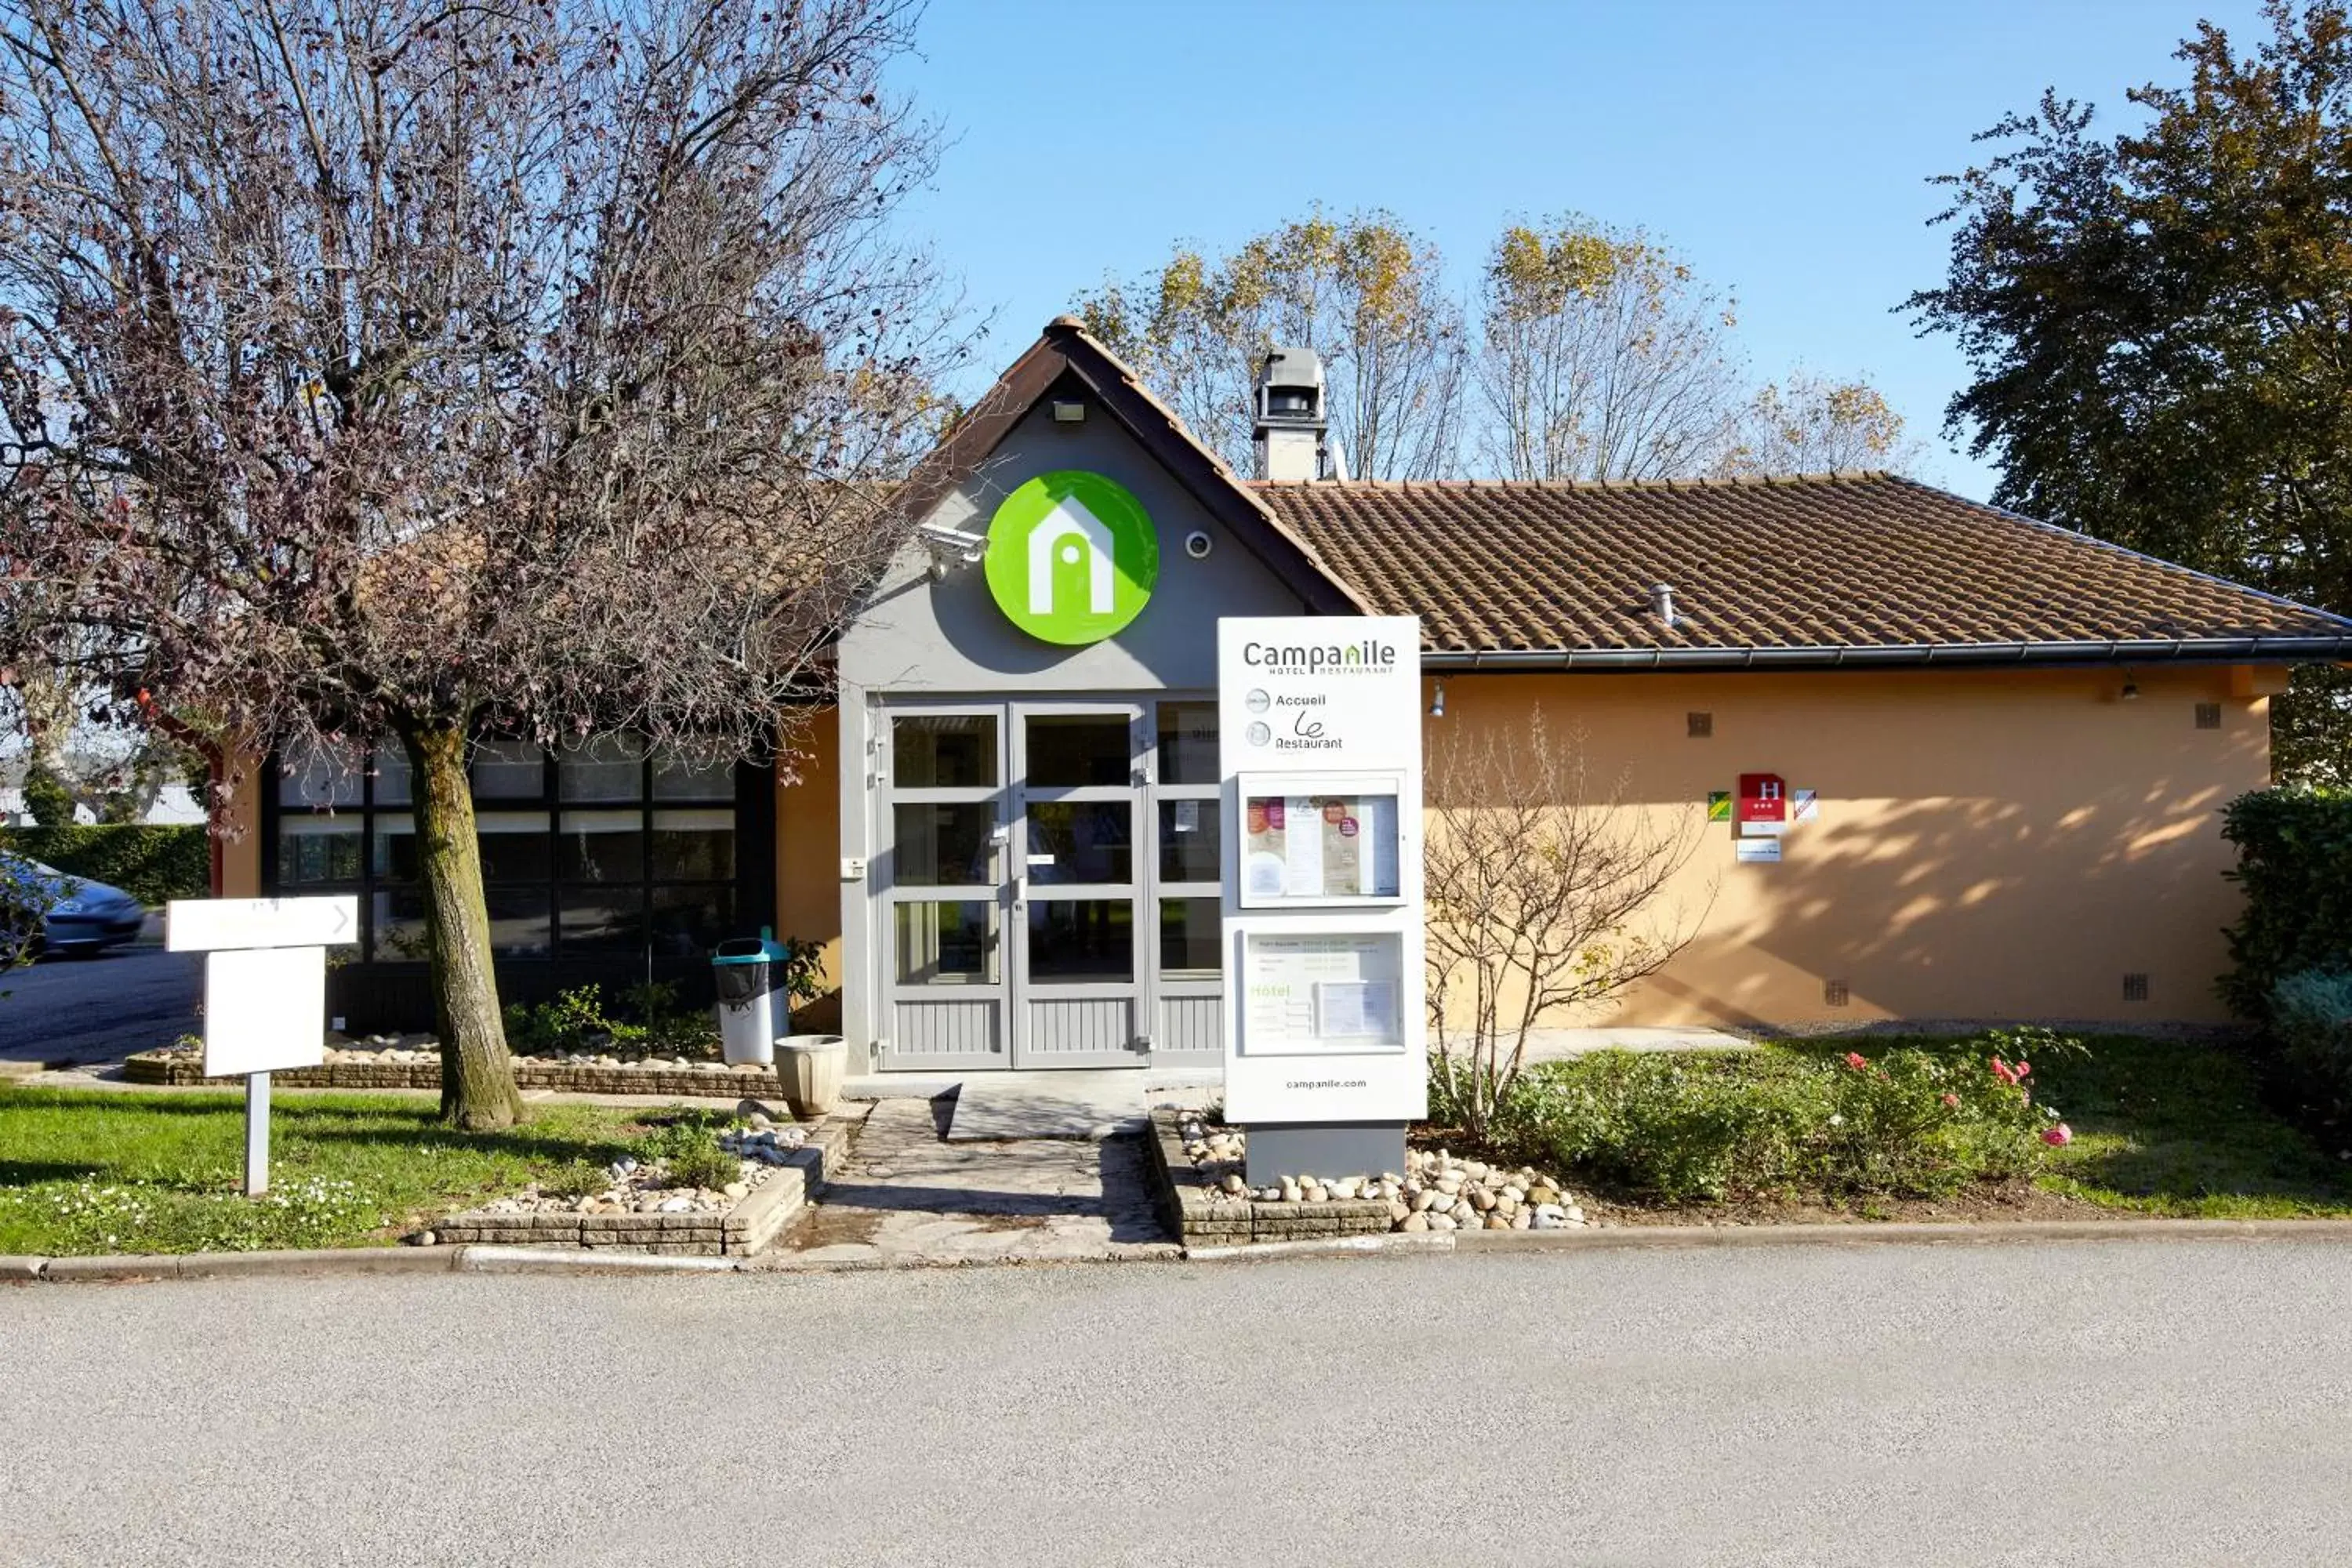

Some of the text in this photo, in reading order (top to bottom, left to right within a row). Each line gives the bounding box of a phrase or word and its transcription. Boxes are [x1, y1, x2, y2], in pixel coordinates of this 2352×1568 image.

[1243, 640, 1396, 675] Campanile
[1276, 695, 1327, 706] Accueil
[1276, 739, 1343, 750] Restaurant
[1759, 782, 1779, 800] H
[1287, 1079, 1367, 1091] campanile.com
